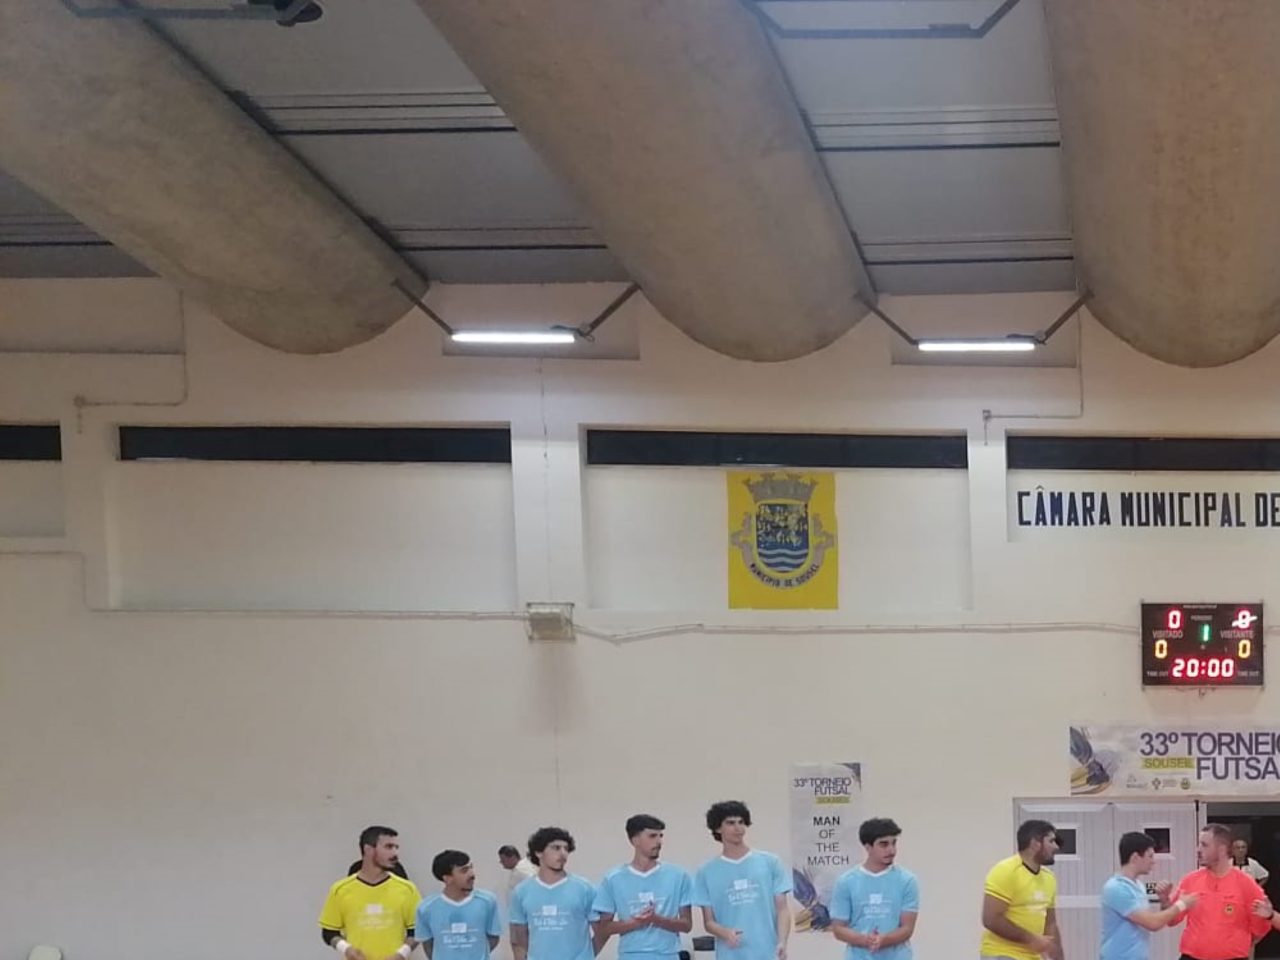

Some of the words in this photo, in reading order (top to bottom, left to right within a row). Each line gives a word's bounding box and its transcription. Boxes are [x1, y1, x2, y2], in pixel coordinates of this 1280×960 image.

[1016, 485, 1112, 527] CÂMARA
[1120, 491, 1247, 527] MUNICIPAL
[1168, 610, 1181, 629] 0
[1152, 630, 1184, 639] VISITADO
[1203, 624, 1210, 642] 1
[1220, 630, 1254, 639] VISITANTE
[1155, 639, 1168, 658] 0
[1238, 639, 1251, 658] 0
[1172, 658, 1235, 677] 20:00
[809, 777, 852, 788] TORNEIO
[814, 787, 851, 796] FUTSAL
[813, 816, 840, 826] MAN
[819, 830, 836, 840] OF
[816, 843, 840, 853] THE
[808, 856, 850, 866] MATCH
